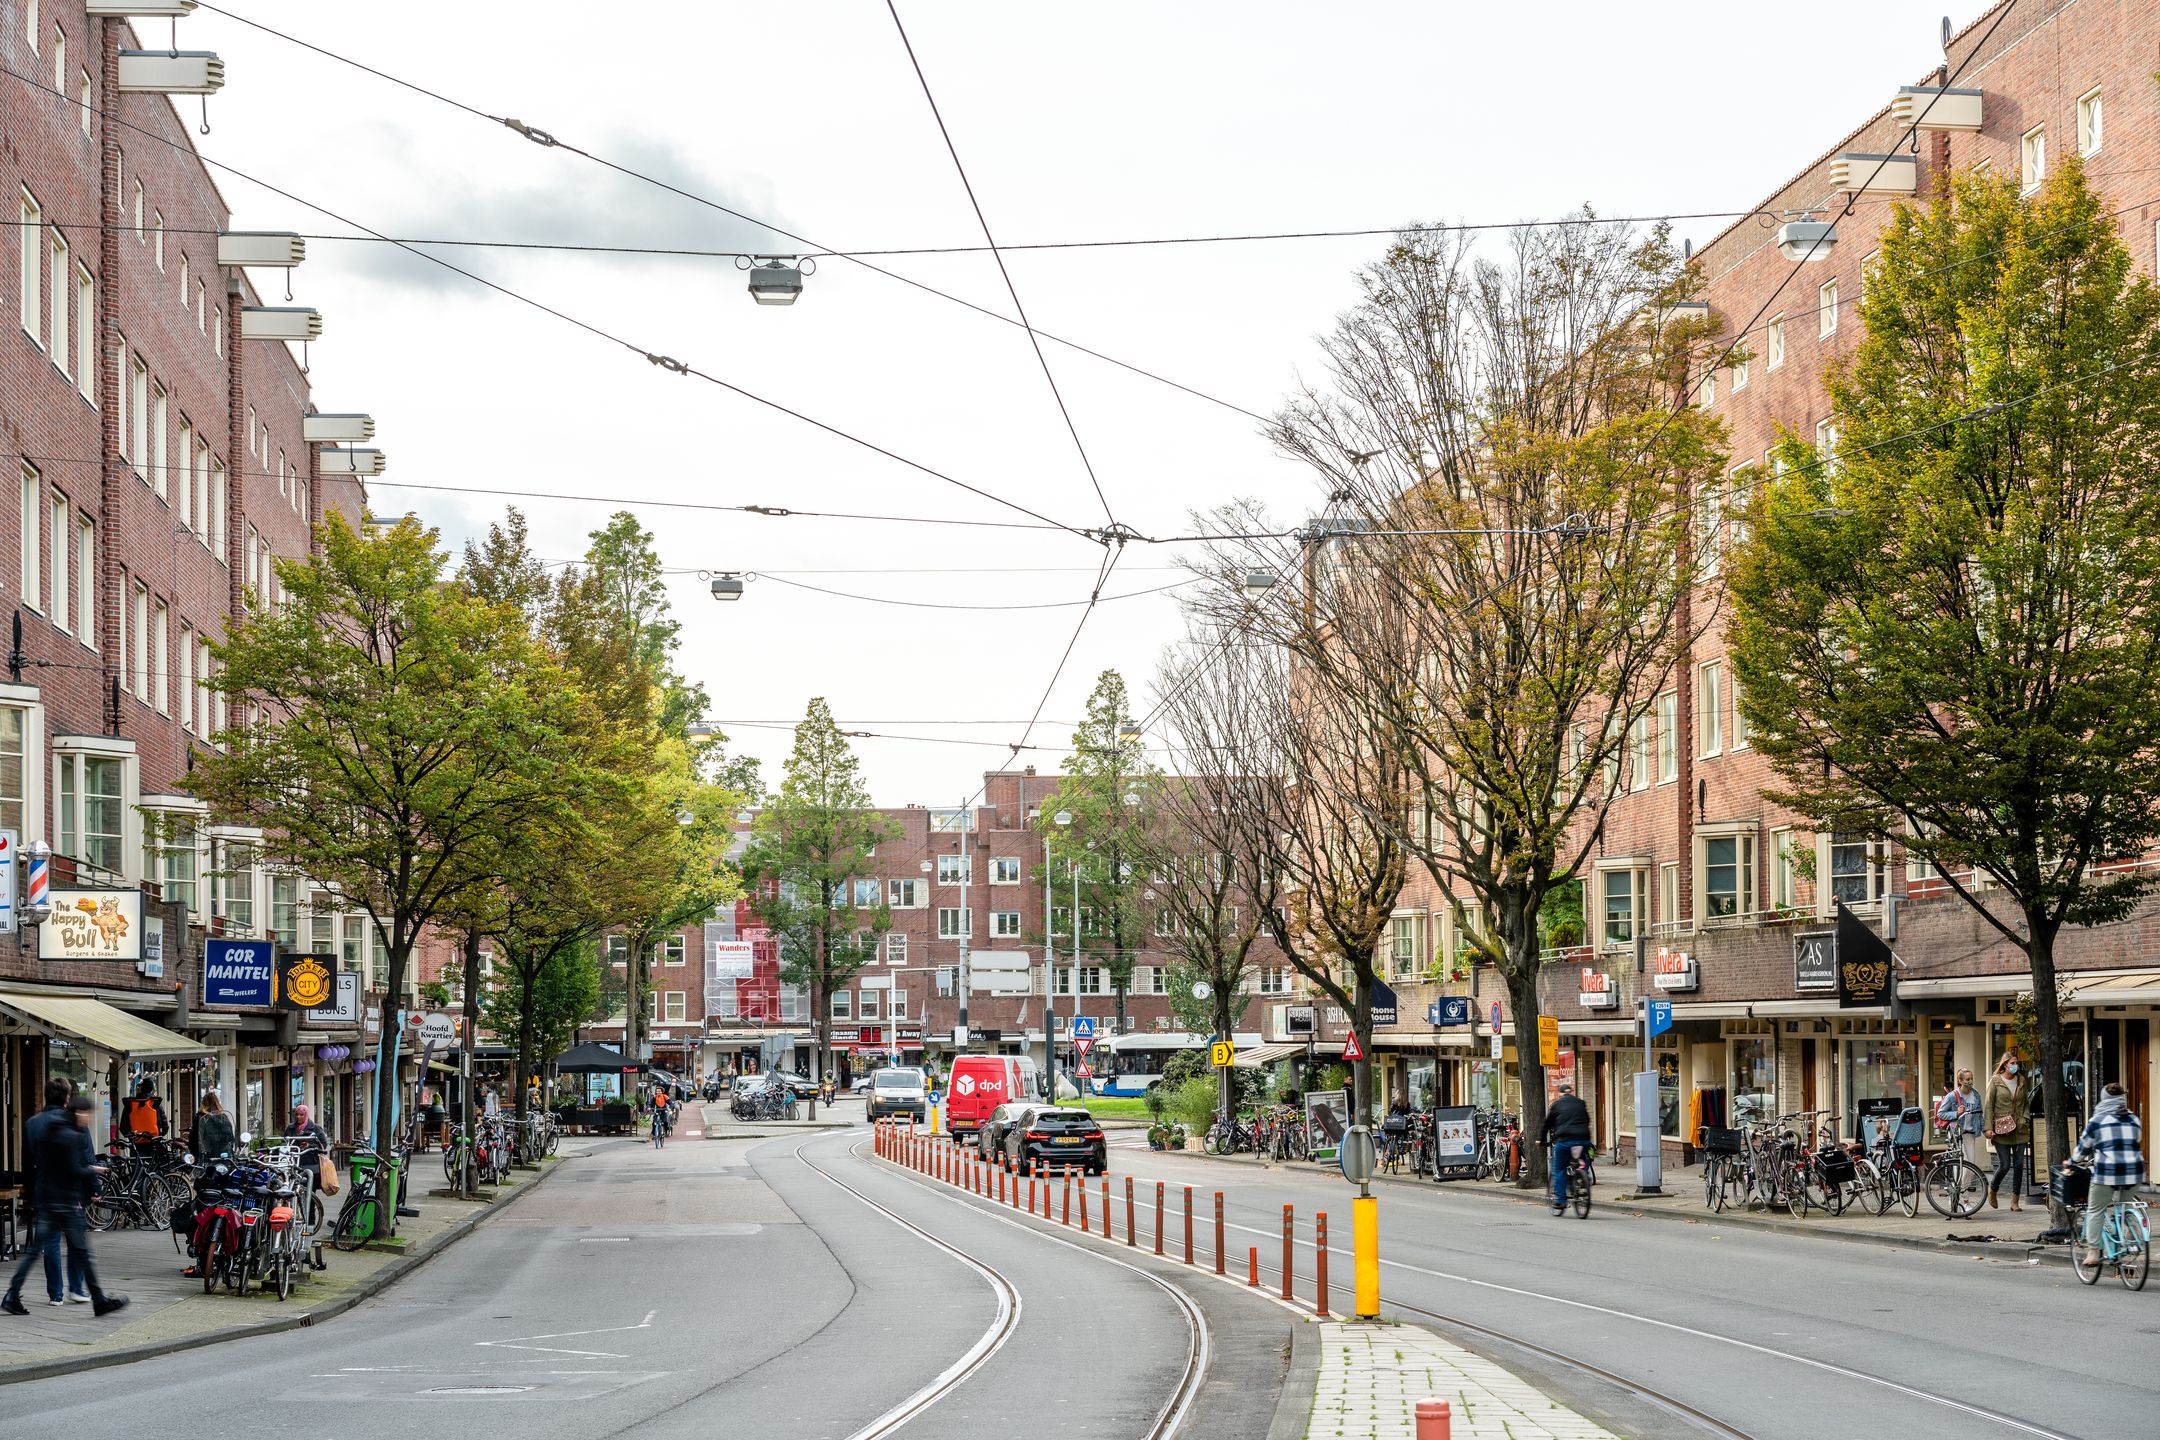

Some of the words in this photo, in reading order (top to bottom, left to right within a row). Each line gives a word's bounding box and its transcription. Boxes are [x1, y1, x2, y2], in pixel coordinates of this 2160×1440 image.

[55, 901, 70, 912] The
[51, 913, 86, 930] Happy
[61, 928, 97, 948] Bull
[719, 944, 750, 952] Wanders
[1807, 942, 1822, 965] AS
[225, 948, 255, 964] COR
[207, 964, 270, 980] MANTEL
[298, 981, 318, 989] CITY
[1289, 1010, 1312, 1018] SUSHI
[1656, 1011, 1666, 1025] P
[902, 1030, 921, 1038] Away
[1217, 1049, 1224, 1061] B
[979, 1079, 1002, 1092] dpd
